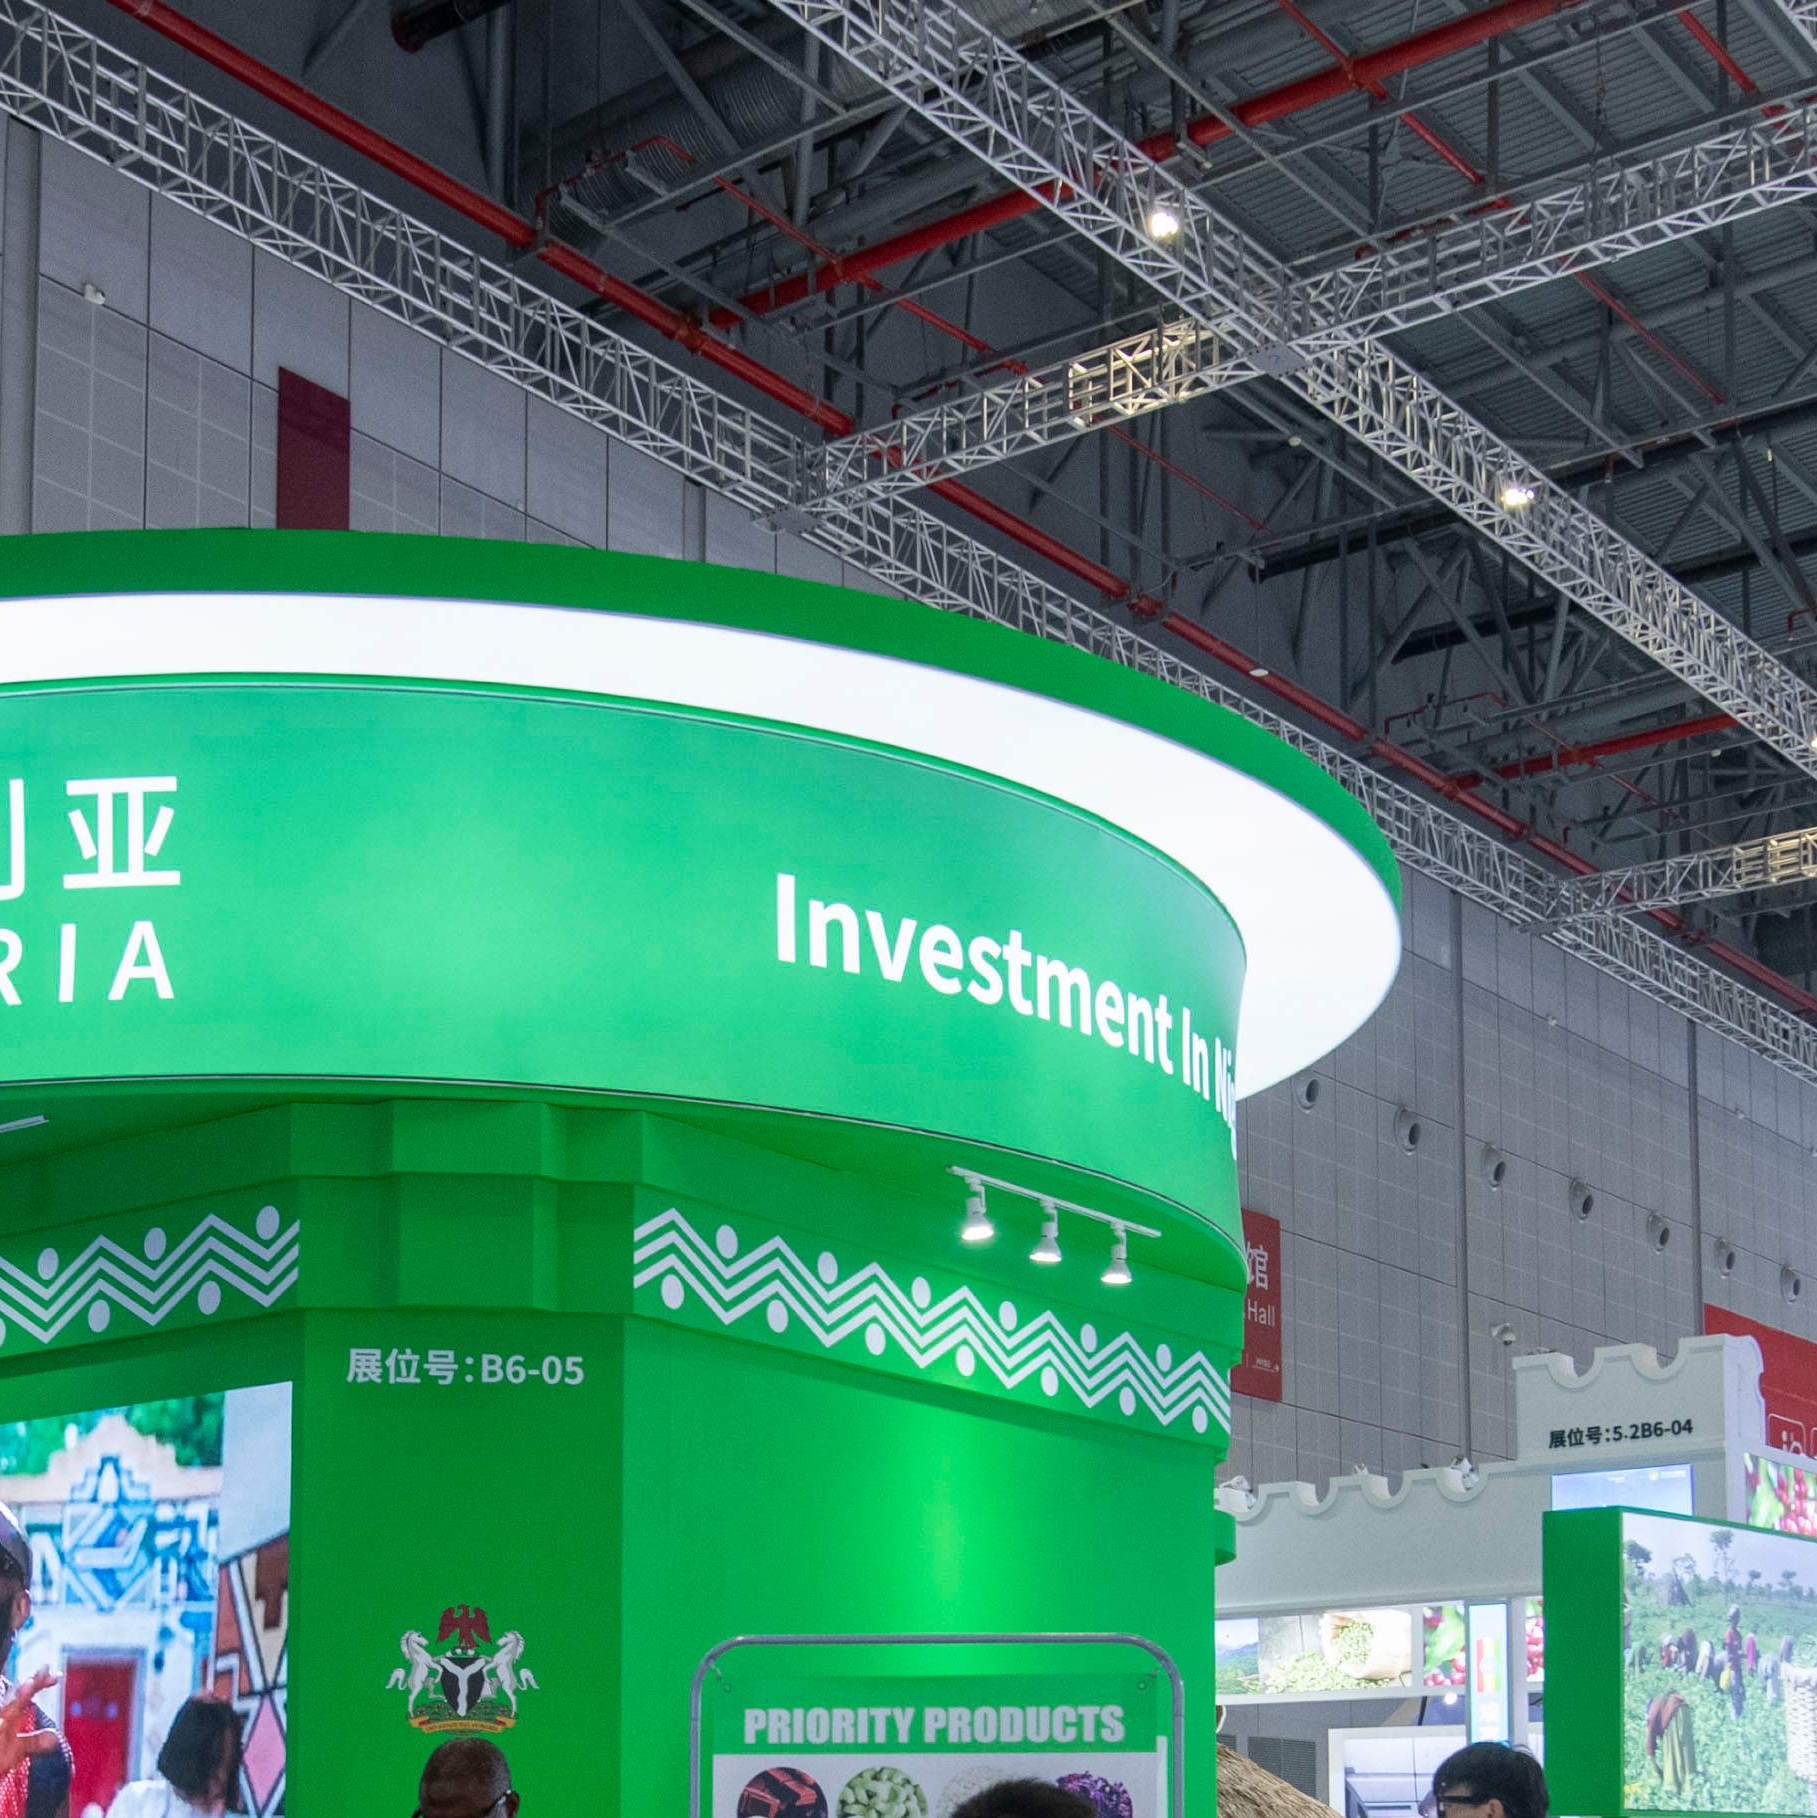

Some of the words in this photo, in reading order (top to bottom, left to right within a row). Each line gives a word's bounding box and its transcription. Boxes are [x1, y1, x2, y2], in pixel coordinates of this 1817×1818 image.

[777, 872, 1174, 1076] Investment
[1182, 1006, 1210, 1101] In
[1247, 1298, 1276, 1327] Hall
[744, 1708, 914, 1744] PRIORITY
[924, 1705, 1125, 1744] PRODUCTS
